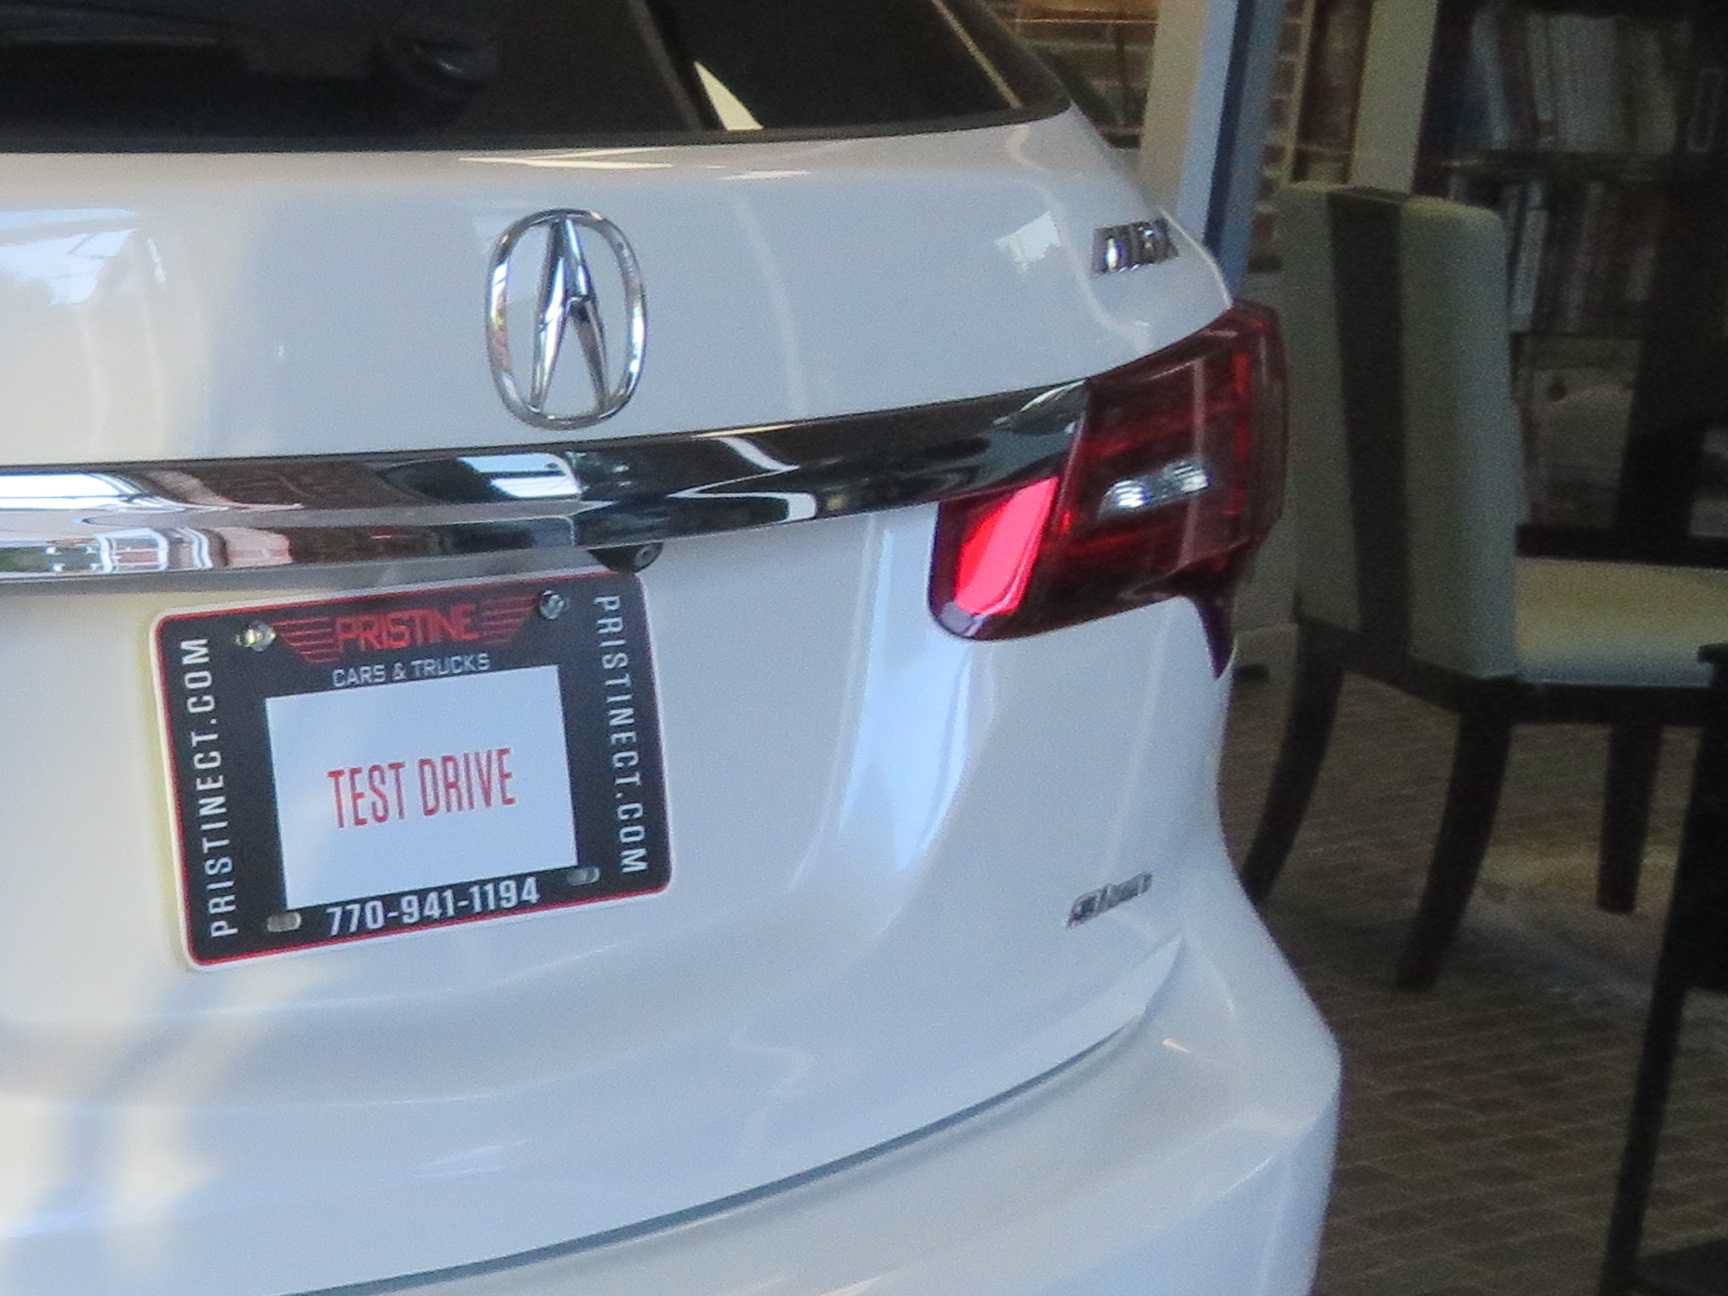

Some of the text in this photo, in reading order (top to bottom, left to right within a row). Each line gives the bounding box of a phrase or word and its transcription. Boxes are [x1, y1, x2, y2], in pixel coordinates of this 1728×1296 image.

[335, 603, 480, 651] PRISTINE
[332, 653, 490, 687] CARS & TRUCKS
[594, 595, 649, 874] PRISTINECT.COM
[180, 638, 239, 938] PRISTINECT.COM
[327, 748, 517, 829] TEST DRIVE
[326, 876, 541, 936] 770-941-1194
